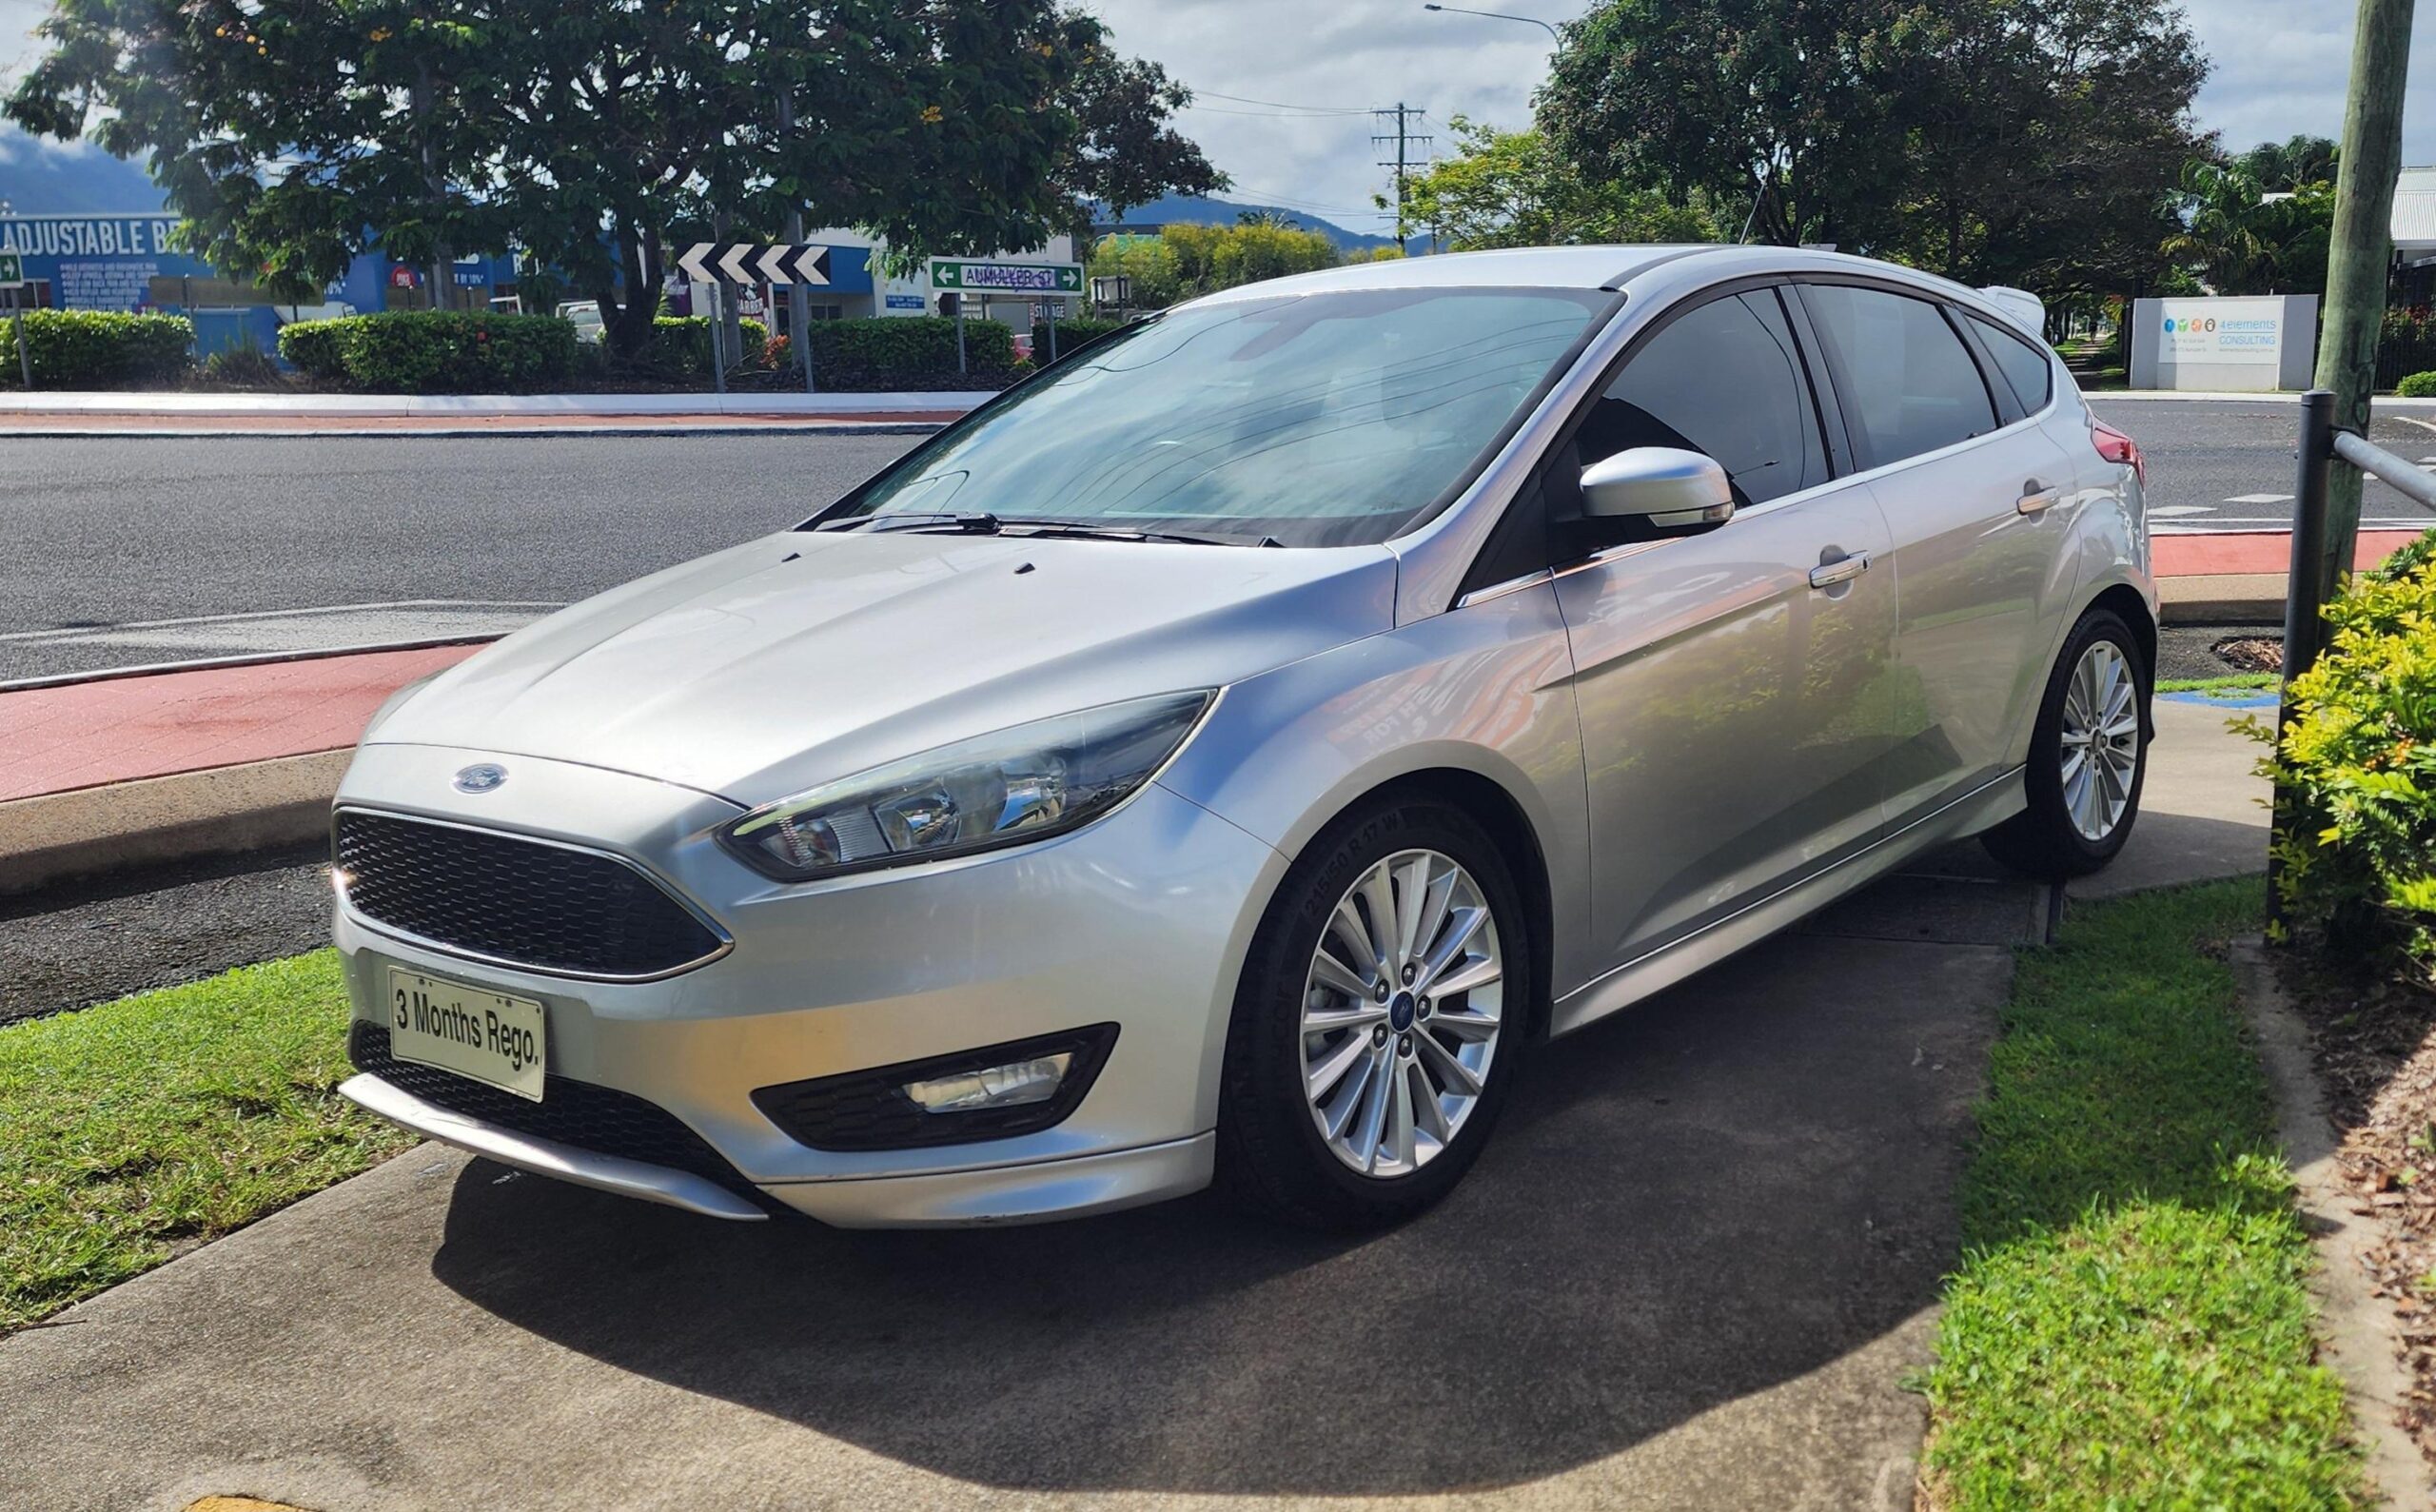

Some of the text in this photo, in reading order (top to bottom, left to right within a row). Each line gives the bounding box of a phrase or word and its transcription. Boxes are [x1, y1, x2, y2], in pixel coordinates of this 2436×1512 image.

[4, 220, 147, 256] ADJUSTABLE
[1034, 304, 1066, 320] STAGE
[2218, 335, 2276, 345] CONSULTING
[396, 989, 540, 1071] 3 Months Rego.
